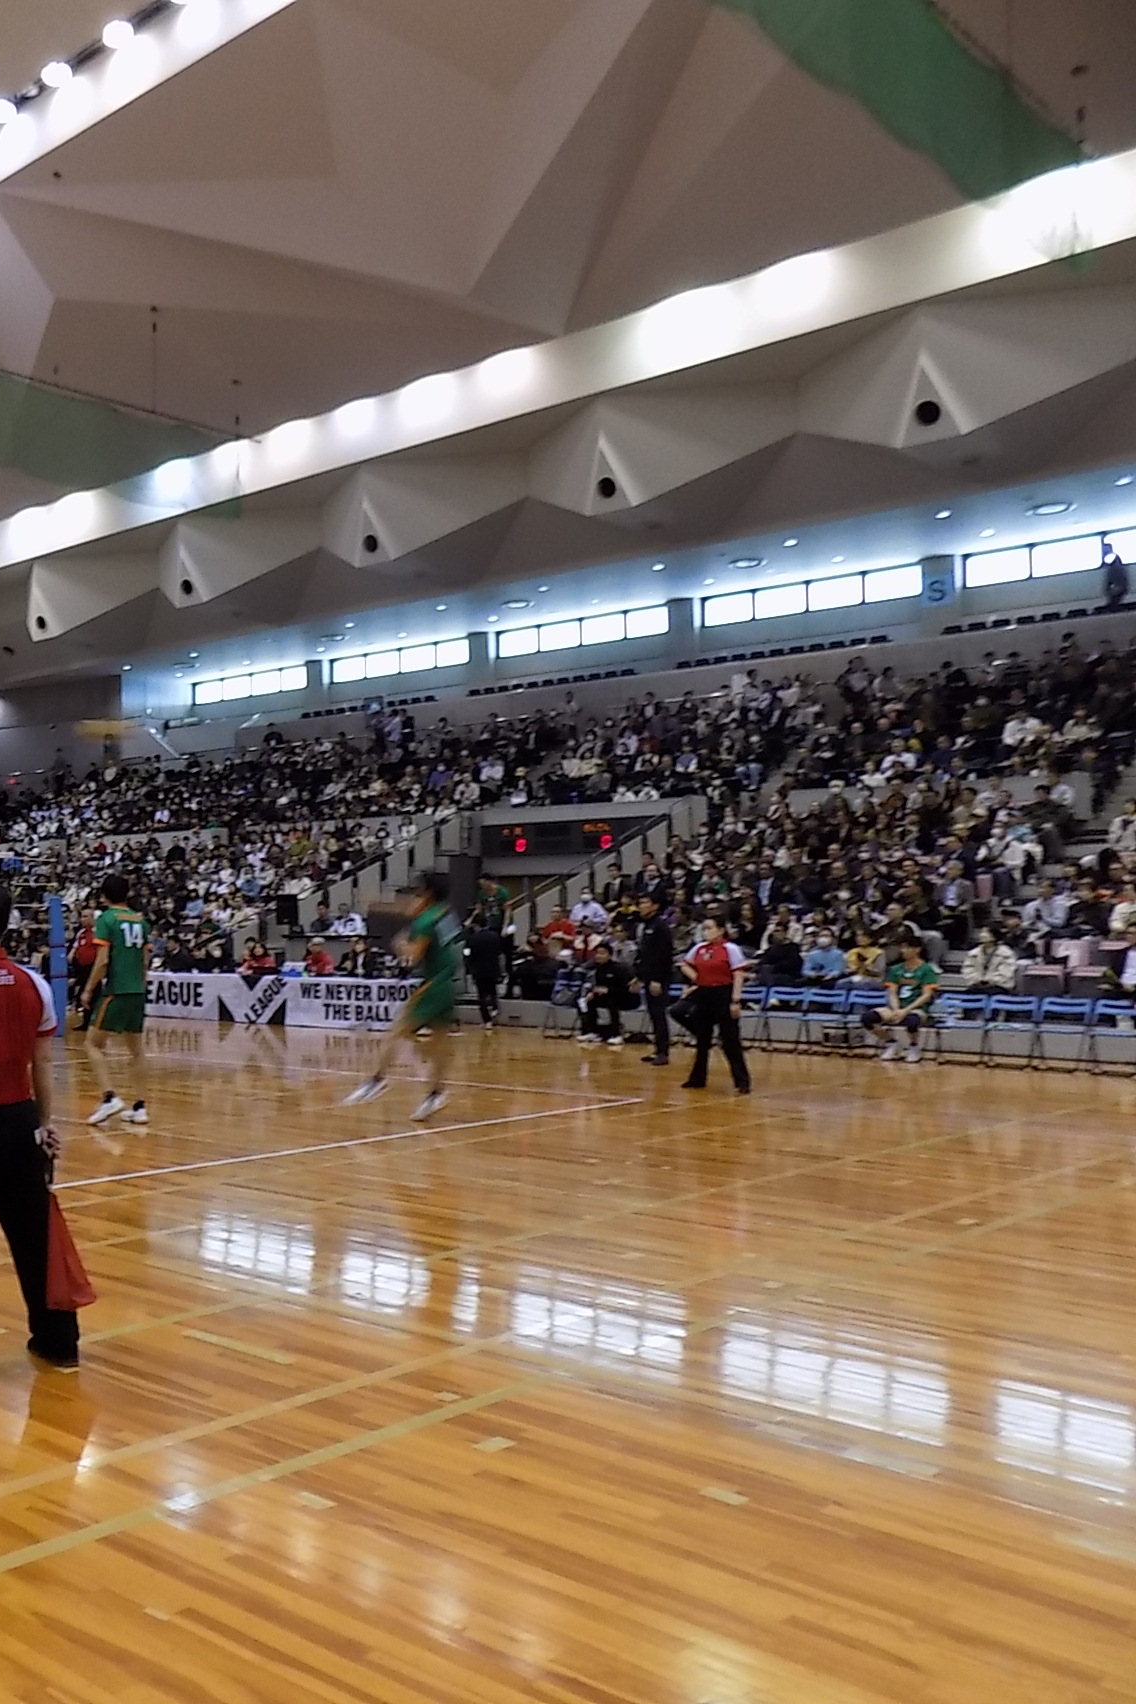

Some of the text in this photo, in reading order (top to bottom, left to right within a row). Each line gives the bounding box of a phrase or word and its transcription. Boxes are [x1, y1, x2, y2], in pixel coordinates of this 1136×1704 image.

[928, 580, 946, 601] S
[120, 922, 144, 949] 14
[243, 975, 288, 1023] LEAGUE
[300, 982, 322, 999] WE
[325, 983, 373, 1001] NEVER
[323, 1003, 393, 1022] THE BALL
